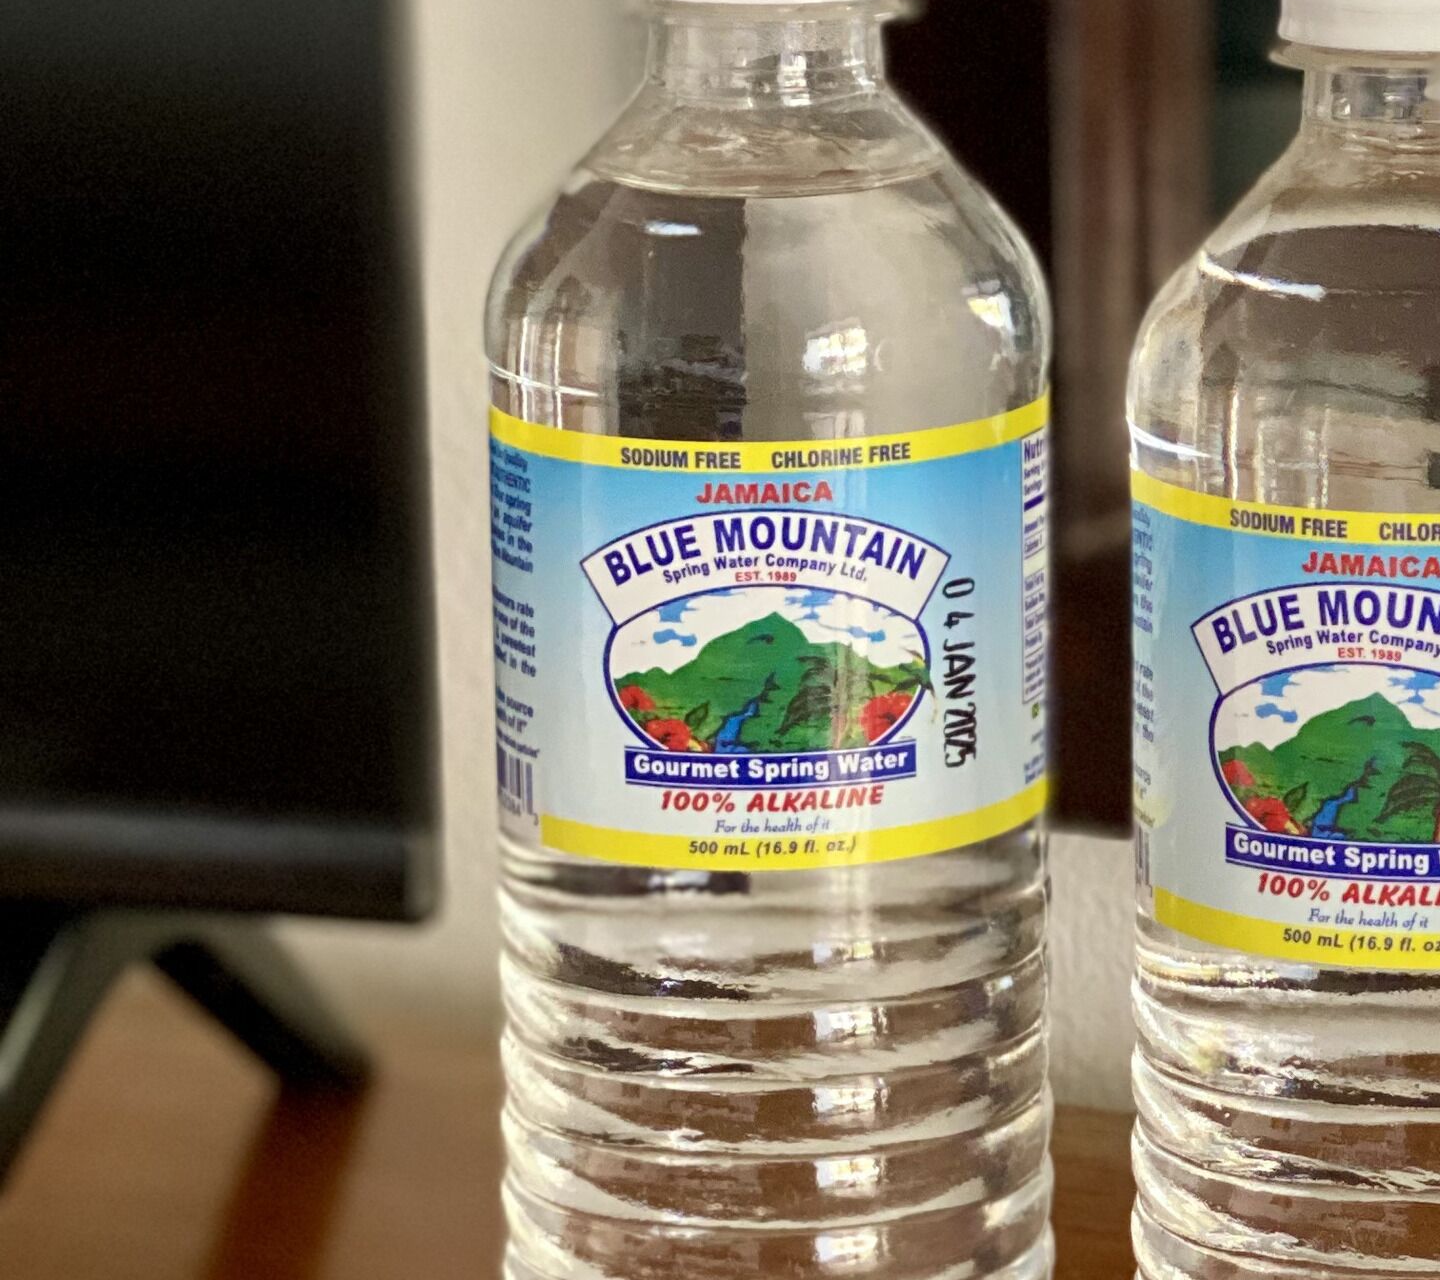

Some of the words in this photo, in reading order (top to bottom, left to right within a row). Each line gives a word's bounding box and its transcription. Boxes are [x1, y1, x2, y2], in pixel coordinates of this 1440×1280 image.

[621, 447, 688, 468] SODIUM
[695, 452, 741, 468] FREE
[771, 447, 863, 468] CHLORINE
[869, 442, 911, 463] FREE
[695, 481, 833, 504] JAMAICA
[1230, 508, 1295, 534] SODIUM
[1301, 517, 1348, 538] FREE
[603, 524, 701, 586] BLUE
[713, 516, 927, 580] MOUNTAIN
[663, 563, 710, 584] Spring
[713, 556, 759, 570] Water
[765, 553, 836, 576] Company
[840, 563, 867, 582] Ltd.
[735, 571, 764, 582] EST.
[768, 571, 797, 582] 1989
[1211, 594, 1305, 654] BLUE
[1266, 634, 1313, 655] Spring
[1316, 630, 1364, 644] Water
[1337, 647, 1367, 659] EST.
[1371, 648, 1402, 661] 1989
[942, 638, 977, 700] JAN
[634, 754, 739, 778] Gourmet
[748, 758, 830, 783] Spring
[837, 751, 908, 774] Water
[661, 791, 736, 813] 100%
[746, 785, 884, 813] ALKALINE
[715, 819, 736, 833] For
[741, 818, 760, 833] the
[764, 817, 802, 832] health
[806, 816, 820, 834] of
[822, 819, 830, 830] it
[689, 841, 718, 854] 500
[724, 841, 750, 856] mL
[756, 840, 798, 858] (16.9
[804, 839, 819, 854] fl.
[1233, 832, 1336, 866] Gourmet
[1344, 847, 1429, 876] Spring
[1258, 872, 1330, 901] 100%
[1307, 907, 1331, 923] For
[1335, 908, 1354, 925] the
[1358, 910, 1397, 928] health
[1402, 911, 1418, 930] of
[1419, 916, 1429, 929] it
[1283, 928, 1312, 944] 500
[1317, 933, 1344, 948] mL
[1350, 935, 1393, 952] (16.9
[1400, 937, 1416, 952] fl.
